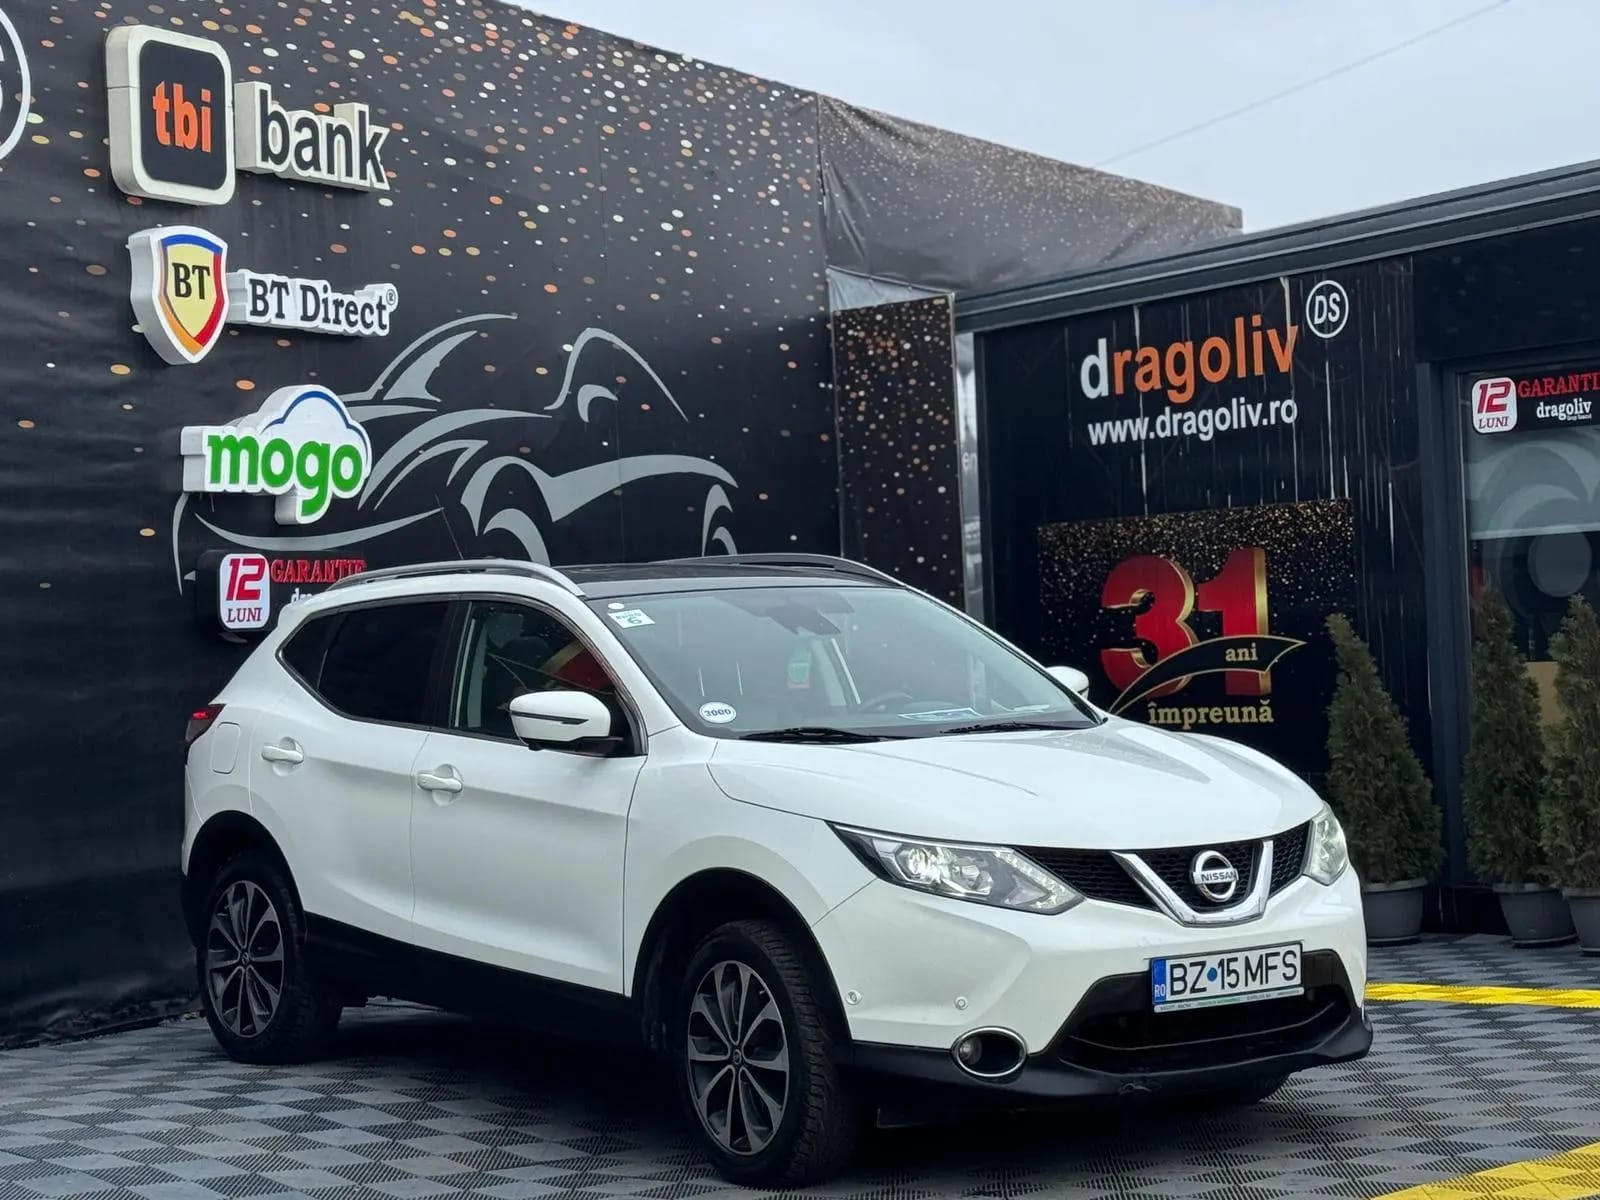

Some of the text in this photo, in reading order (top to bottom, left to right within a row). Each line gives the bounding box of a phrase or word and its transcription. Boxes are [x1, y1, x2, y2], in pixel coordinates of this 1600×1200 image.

[152, 81, 385, 185] tbi bank
[172, 263, 210, 300] BT
[249, 279, 290, 319] BT
[1314, 292, 1340, 325] DS
[1080, 315, 1299, 404] dragoliv
[1477, 381, 1512, 414] 12
[1536, 397, 1592, 421] dragoliv
[1087, 397, 1298, 446] www.dragoliv.ro
[1479, 416, 1509, 430] LUNI
[207, 434, 363, 517] mogo
[226, 558, 265, 601] 12
[226, 607, 262, 623] LUNI
[1101, 548, 1271, 699] 31
[1225, 643, 1258, 662] ani
[1148, 700, 1274, 730] împreună
[1201, 871, 1237, 881] NISSAN
[1155, 983, 1166, 997] RO
[1170, 950, 1297, 996] BZ 15 MFS
